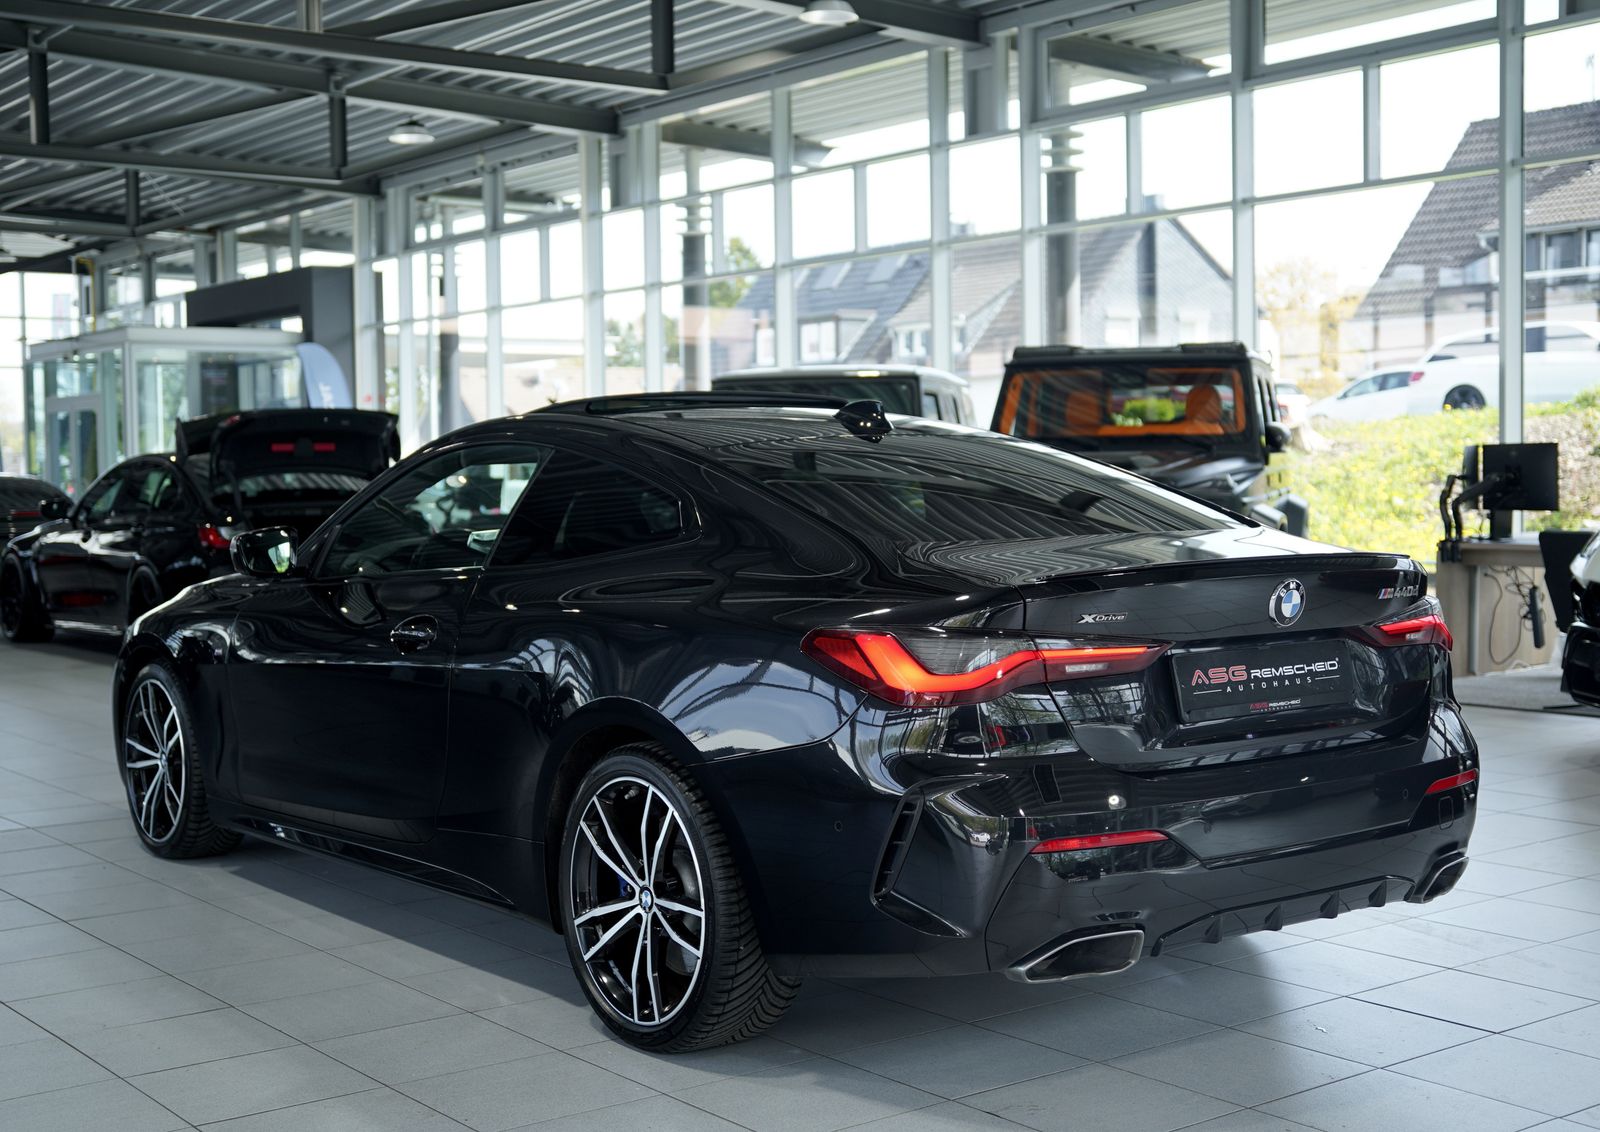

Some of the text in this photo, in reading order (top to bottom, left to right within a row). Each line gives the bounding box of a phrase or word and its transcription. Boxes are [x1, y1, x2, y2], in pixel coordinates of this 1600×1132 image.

[1191, 660, 1339, 686] ASG REMSCHEID
[1226, 677, 1312, 693] AUTOHAUS
